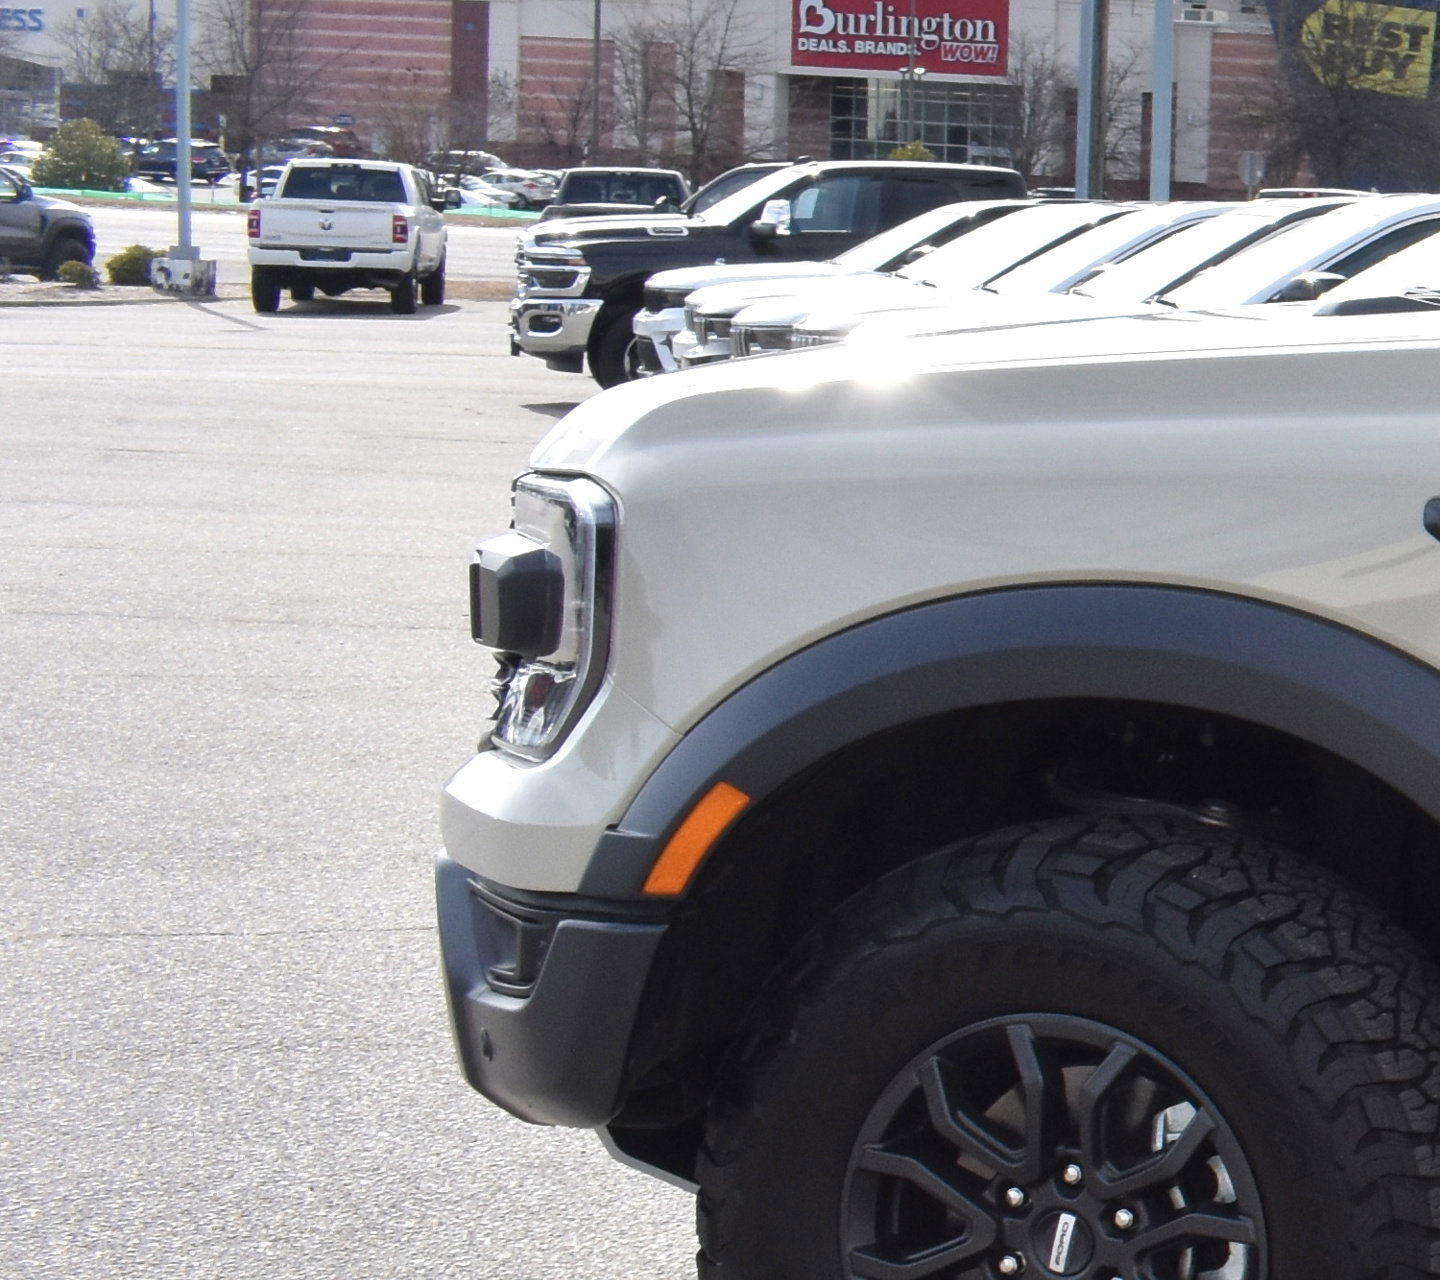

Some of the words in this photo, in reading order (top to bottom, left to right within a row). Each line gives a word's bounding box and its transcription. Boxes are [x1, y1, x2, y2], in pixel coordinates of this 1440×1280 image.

[798, 37, 851, 54] DEALS.
[941, 41, 999, 64] WOW!
[1055, 1221, 1069, 1266] FORD
